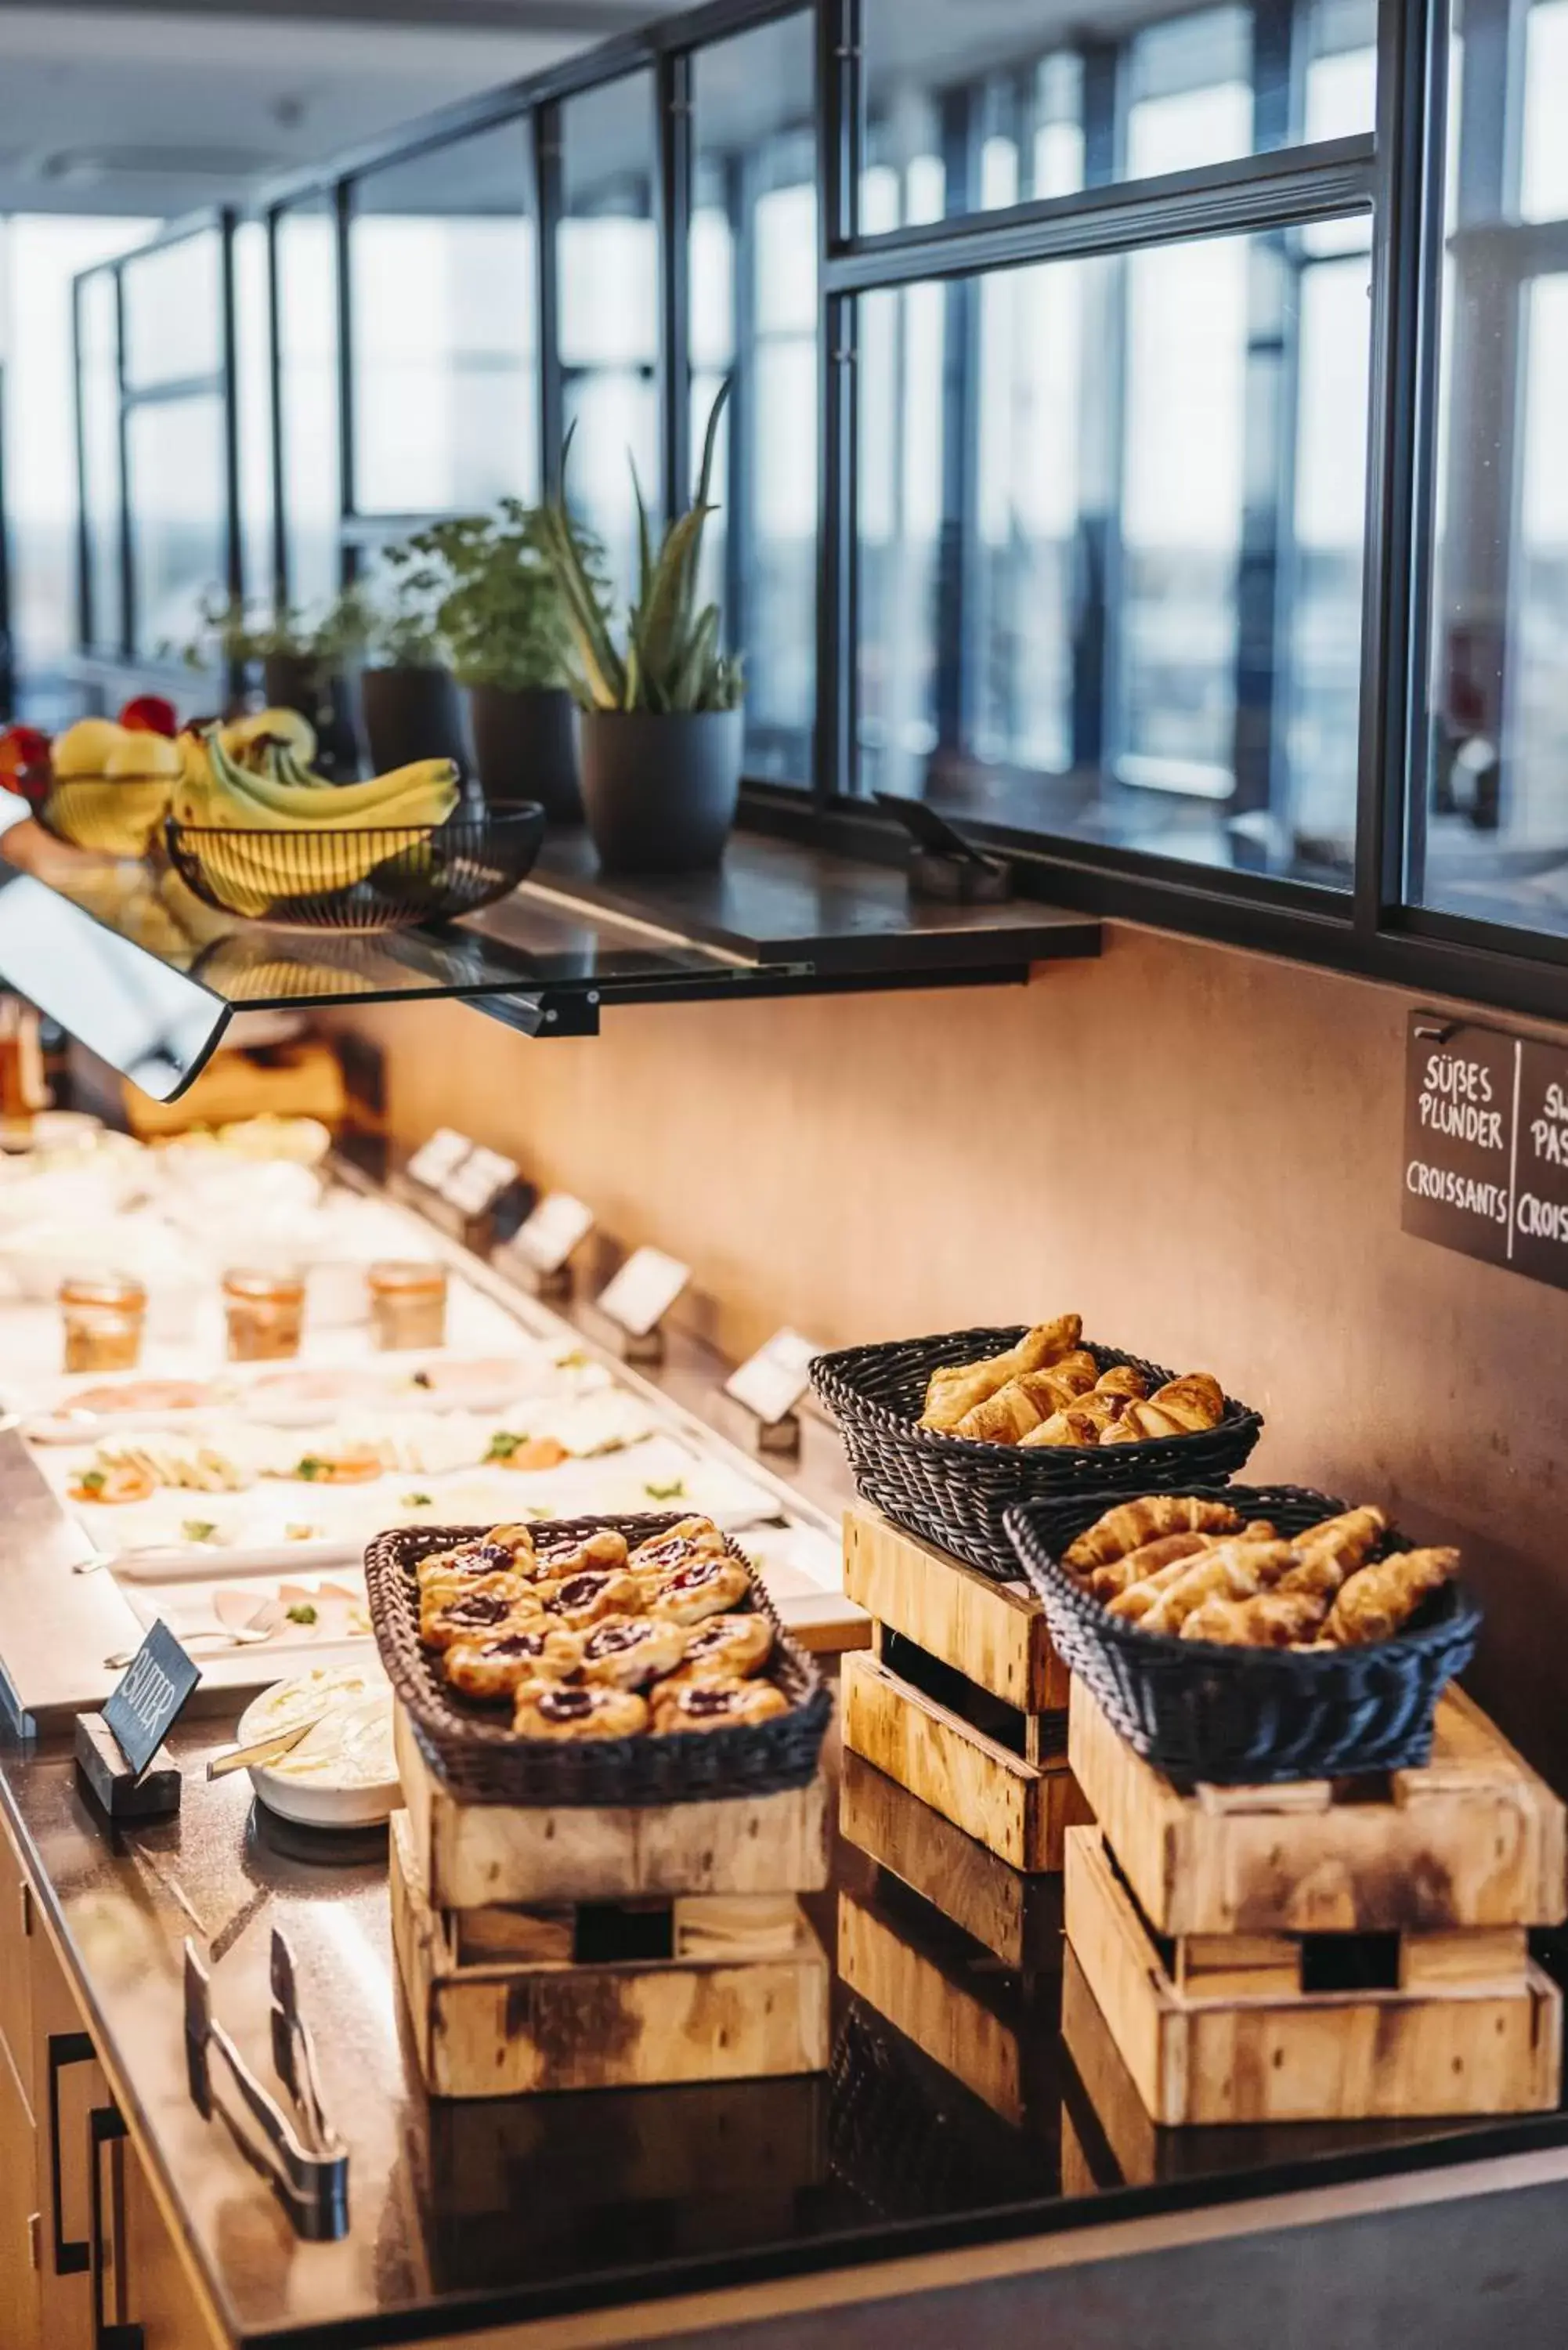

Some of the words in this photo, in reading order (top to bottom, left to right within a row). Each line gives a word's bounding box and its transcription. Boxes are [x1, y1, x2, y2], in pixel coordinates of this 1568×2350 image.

[1418, 1094, 1503, 1150] PLUNDER
[1407, 1161, 1507, 1224] CROISSANTS
[122, 1647, 175, 1737] BUTTER
